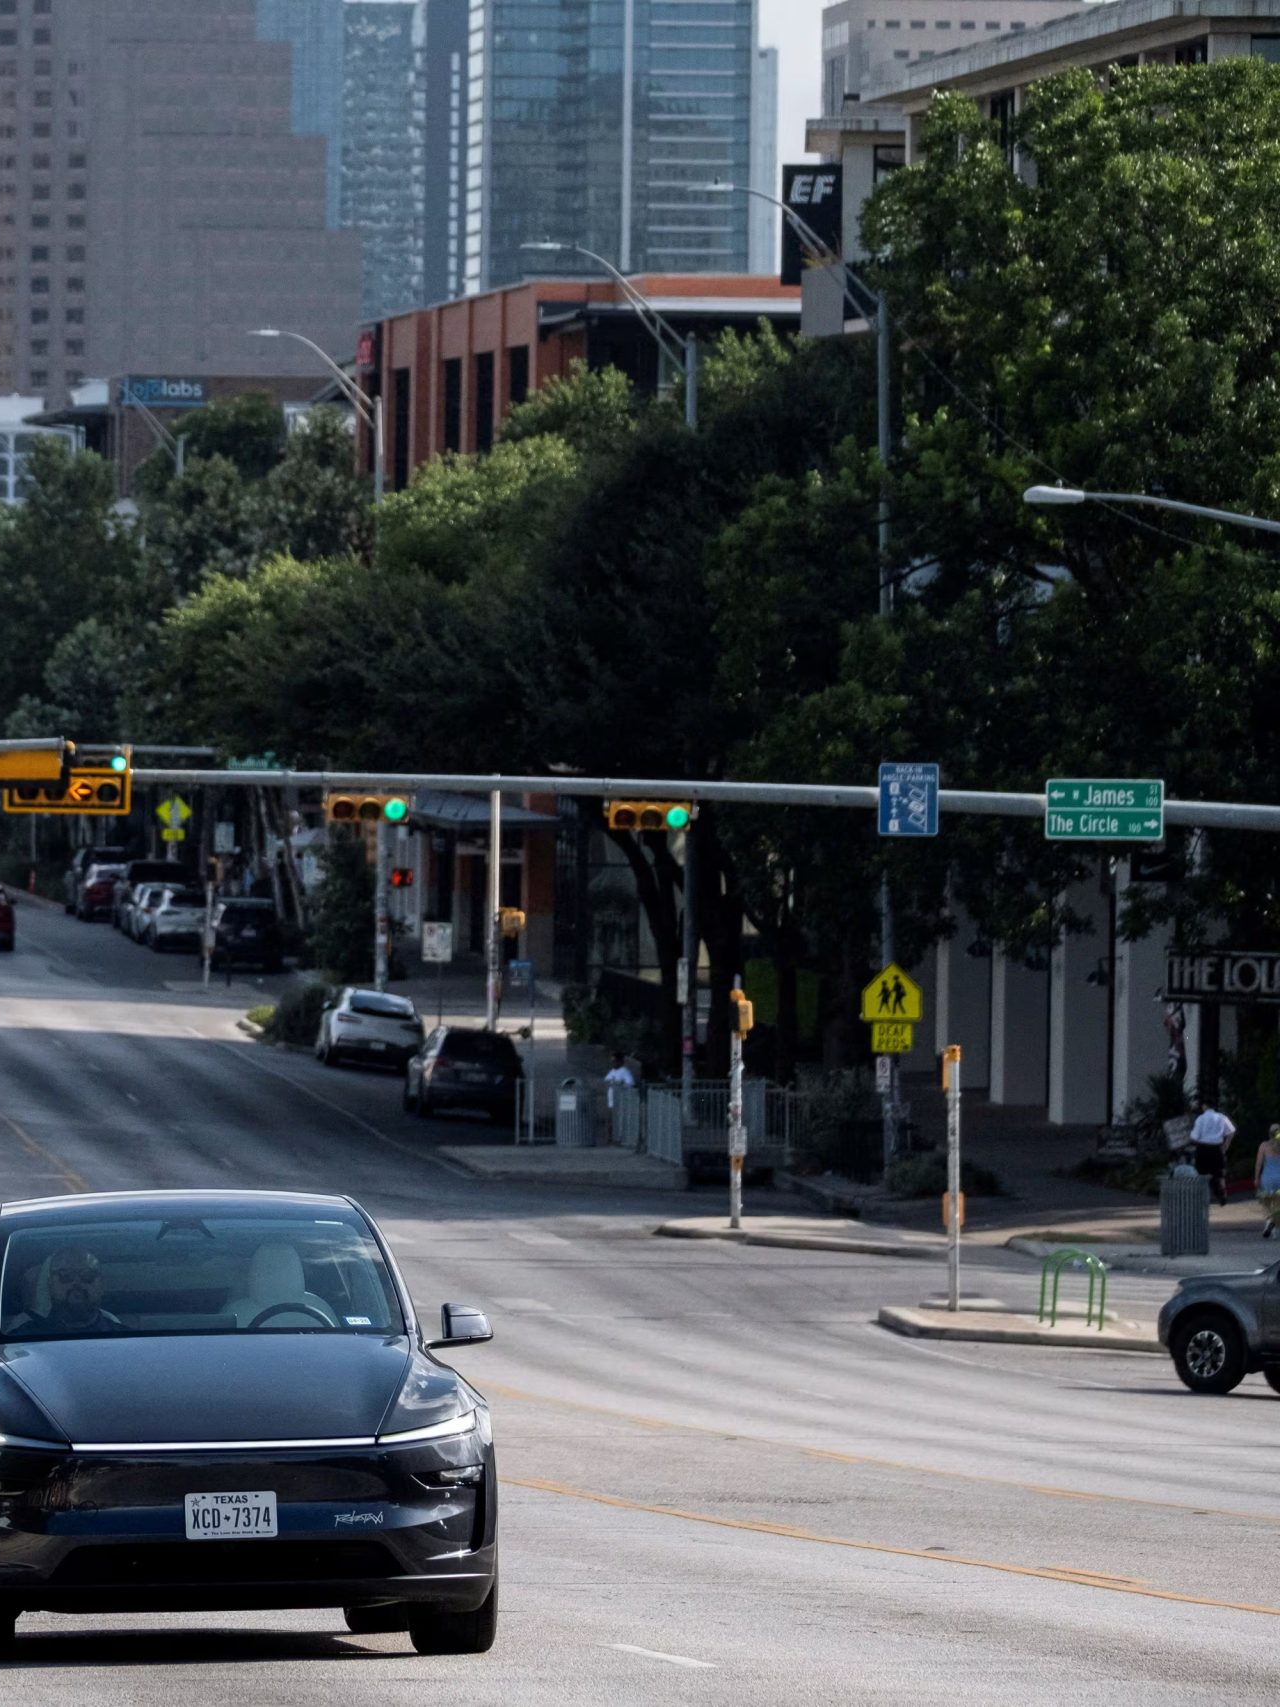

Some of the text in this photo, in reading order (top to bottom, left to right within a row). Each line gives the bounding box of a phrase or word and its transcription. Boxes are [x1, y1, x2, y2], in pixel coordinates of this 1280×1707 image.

[789, 174, 836, 204] EF
[1083, 785, 1134, 806] James
[1146, 797, 1158, 806] 100
[1050, 814, 1141, 833] The Circle 100
[1169, 957, 1218, 992] THE
[213, 1495, 248, 1504] TEXAS
